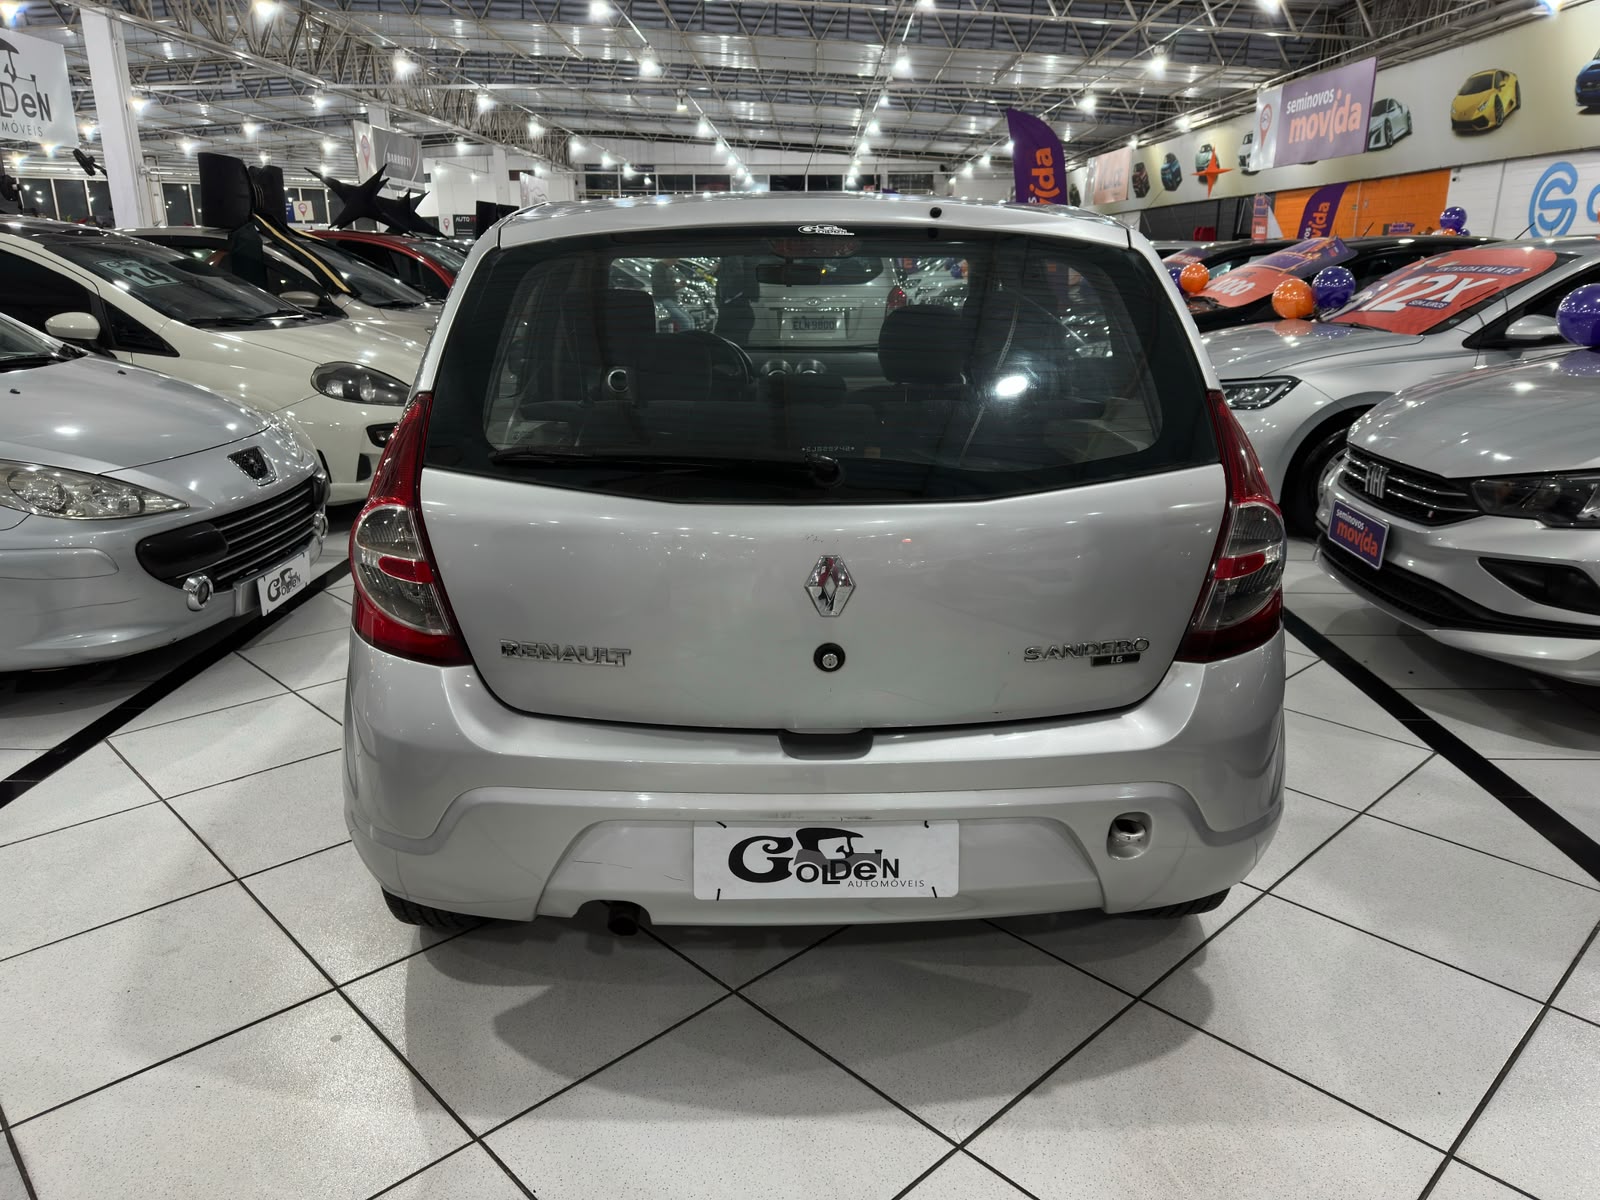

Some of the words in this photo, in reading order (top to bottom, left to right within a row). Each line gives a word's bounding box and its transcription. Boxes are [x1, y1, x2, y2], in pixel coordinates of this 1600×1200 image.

[1286, 88, 1335, 114] seminovos
[1288, 87, 1362, 144] movida
[1358, 274, 1497, 313] 12X
[1364, 461, 1390, 499] FIAT
[1336, 509, 1365, 530] seminovos
[1336, 521, 1379, 557] movida
[500, 639, 631, 667] RENAULT
[1024, 637, 1150, 662] SANDERO
[847, 878, 925, 888] AUTOMÓVEIS
